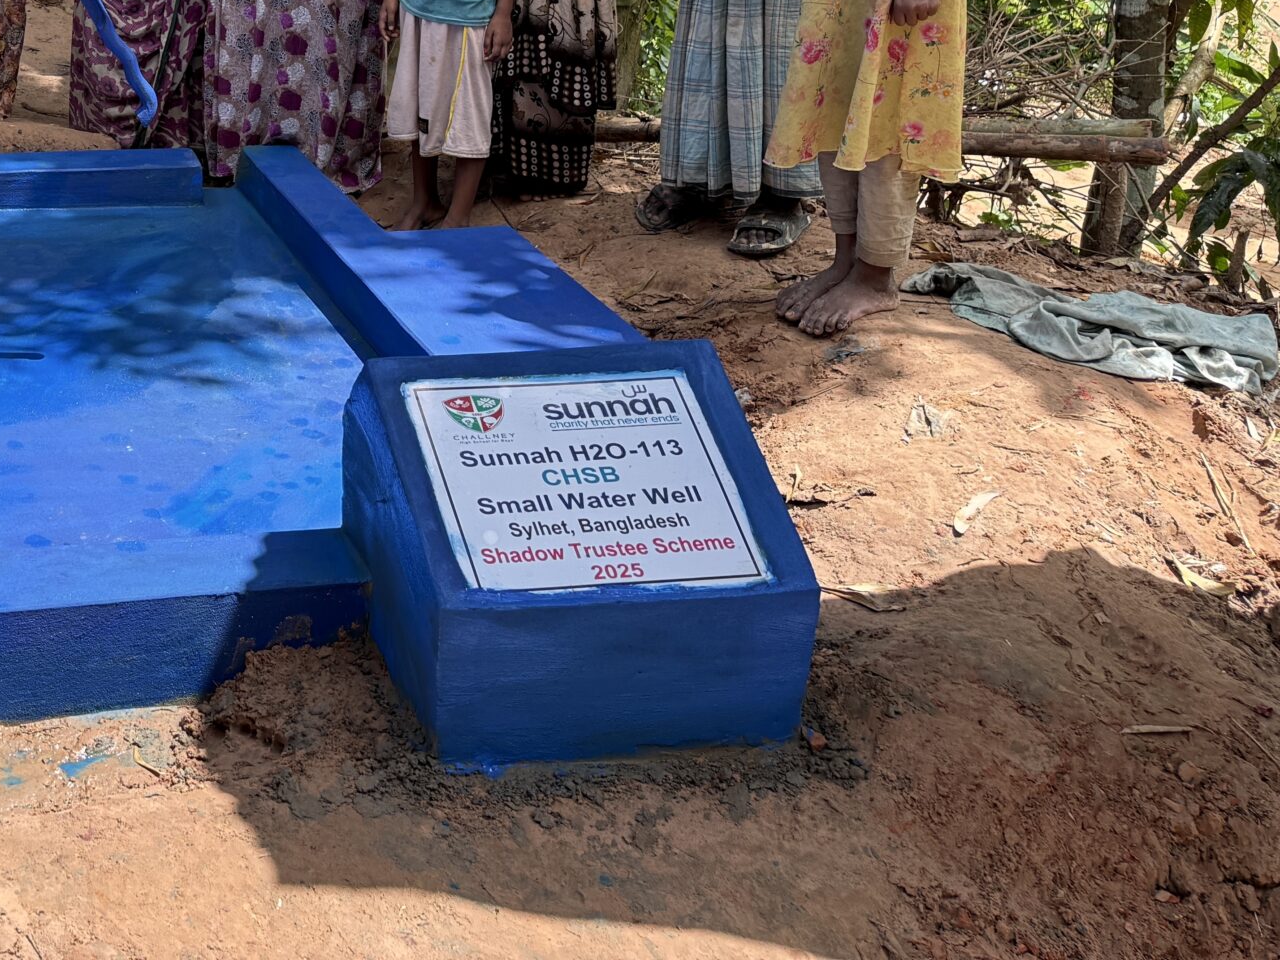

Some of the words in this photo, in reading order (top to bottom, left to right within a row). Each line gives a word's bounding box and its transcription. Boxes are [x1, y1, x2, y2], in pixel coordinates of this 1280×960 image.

[543, 393, 676, 420] sunnah
[549, 419, 588, 429] charity
[591, 417, 616, 427] that
[616, 416, 648, 426] never
[651, 414, 680, 423] ends
[453, 433, 515, 441] CHALLNEY
[459, 447, 563, 467] Sunnah
[569, 439, 683, 461] H2O-113
[541, 466, 620, 486] CHSB
[477, 494, 553, 515] Small
[558, 491, 636, 510] Water
[642, 485, 702, 504] Well
[508, 520, 575, 540] Sylhet,
[578, 512, 690, 534] Bangladesh
[481, 546, 564, 564] Shadow
[568, 541, 648, 559] Trustee
[652, 536, 735, 554] Scheme
[591, 563, 644, 580] 2025
